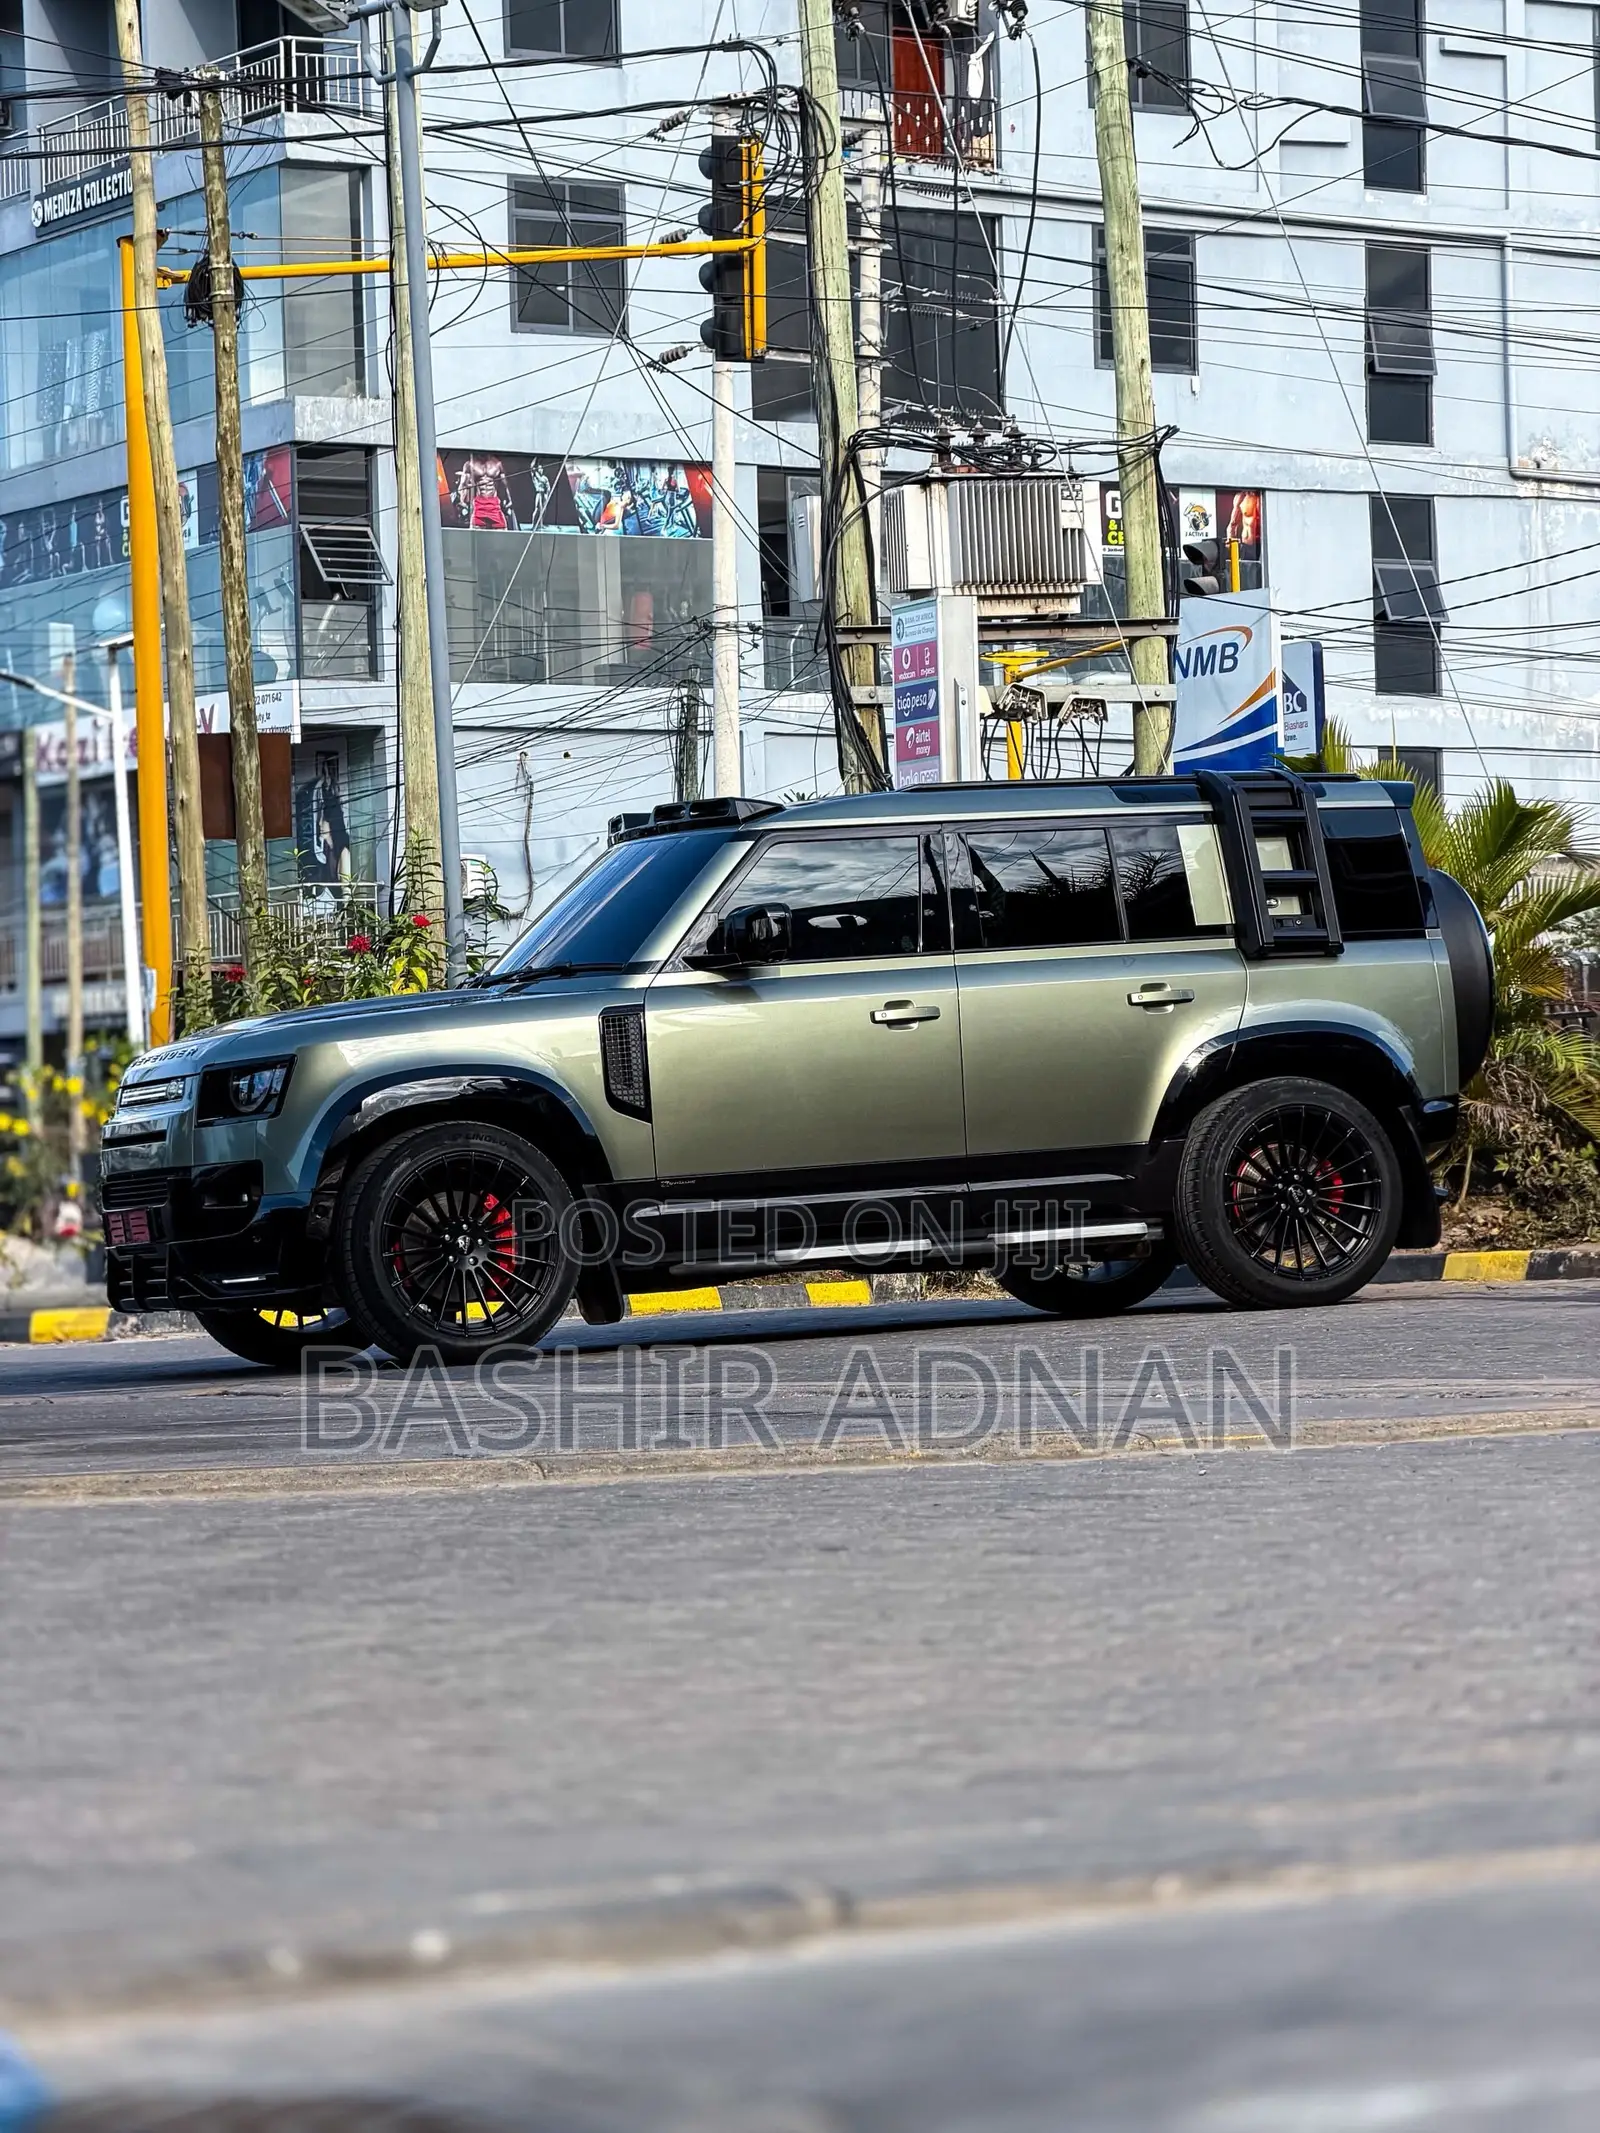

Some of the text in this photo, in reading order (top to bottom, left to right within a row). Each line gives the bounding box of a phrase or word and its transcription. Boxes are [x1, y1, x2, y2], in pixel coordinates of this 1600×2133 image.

[44, 168, 134, 223] MEDUZA COLLECTIO
[1173, 642, 1239, 679] NMB
[1283, 690, 1302, 714] BC
[1284, 719, 1309, 731] Biashara
[915, 729, 931, 744] airtel
[915, 745, 931, 756] money
[131, 1047, 199, 1068] DEFENDER
